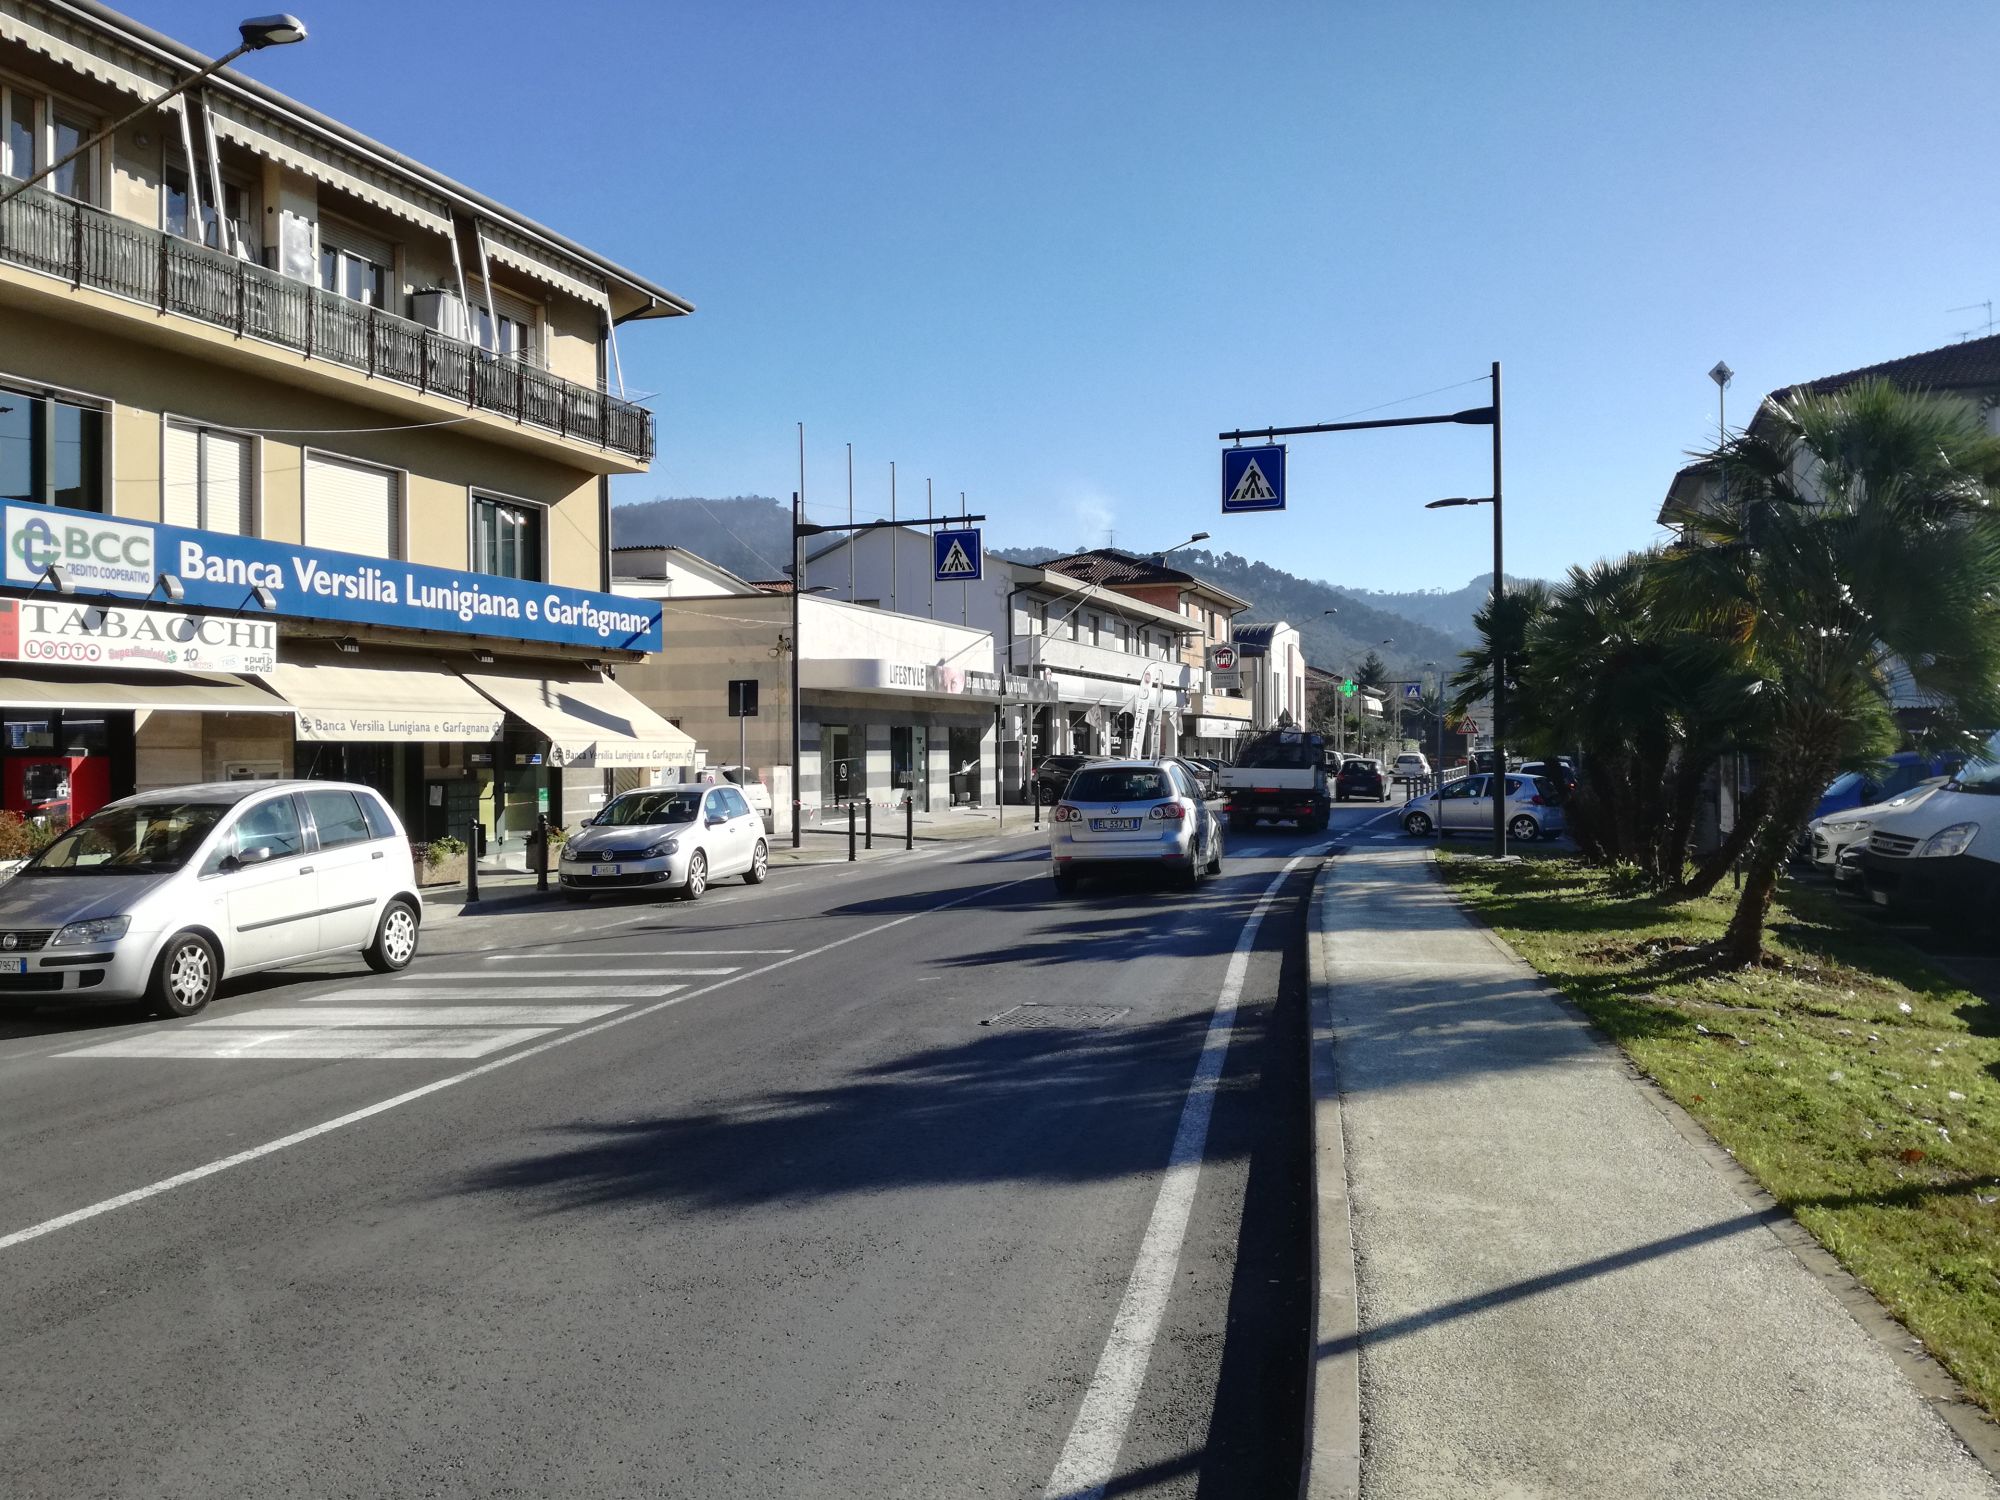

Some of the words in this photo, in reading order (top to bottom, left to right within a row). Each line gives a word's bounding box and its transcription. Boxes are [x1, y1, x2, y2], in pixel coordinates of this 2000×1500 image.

[65, 526, 150, 567] BCC
[66, 562, 98, 578] CREDITO
[100, 565, 150, 583] COOPERATIVO
[180, 541, 284, 589] Banca
[292, 556, 398, 604] Versilia
[406, 574, 520, 622] Lunigiana
[525, 603, 537, 619] e
[544, 596, 652, 637] Garfagnana
[22, 604, 275, 651] TABACCHI
[25, 639, 101, 662] LOTTO
[183, 648, 199, 662] 10
[889, 663, 925, 686] LIFESTYLE
[315, 719, 346, 732] Banca
[350, 719, 385, 733] Versilia
[388, 720, 431, 735] Lunigiana
[434, 724, 439, 733] e
[442, 722, 490, 736] Garfagnana
[565, 749, 587, 760] Banca
[589, 749, 613, 760] Versilia
[615, 750, 644, 762] Lunigiana
